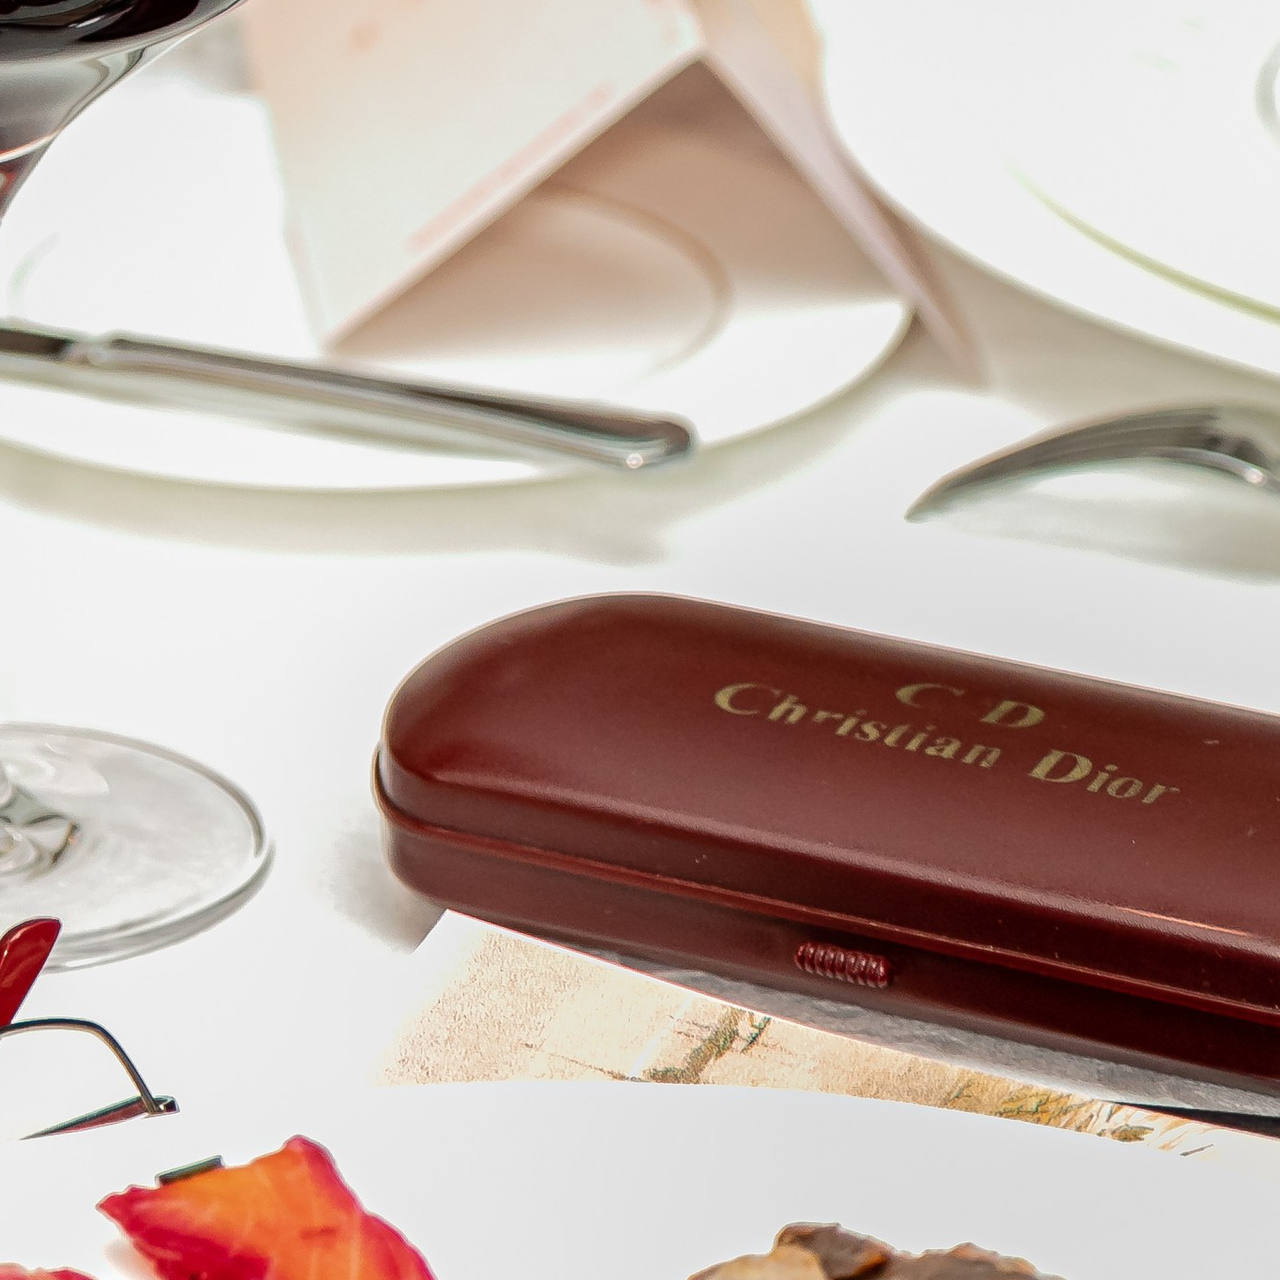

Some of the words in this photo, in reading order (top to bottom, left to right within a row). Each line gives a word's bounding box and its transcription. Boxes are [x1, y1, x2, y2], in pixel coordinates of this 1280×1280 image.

[713, 681, 1001, 769] Christian
[1028, 747, 1182, 806] Dior
[895, 682, 965, 709] C
[979, 699, 1046, 729] D
